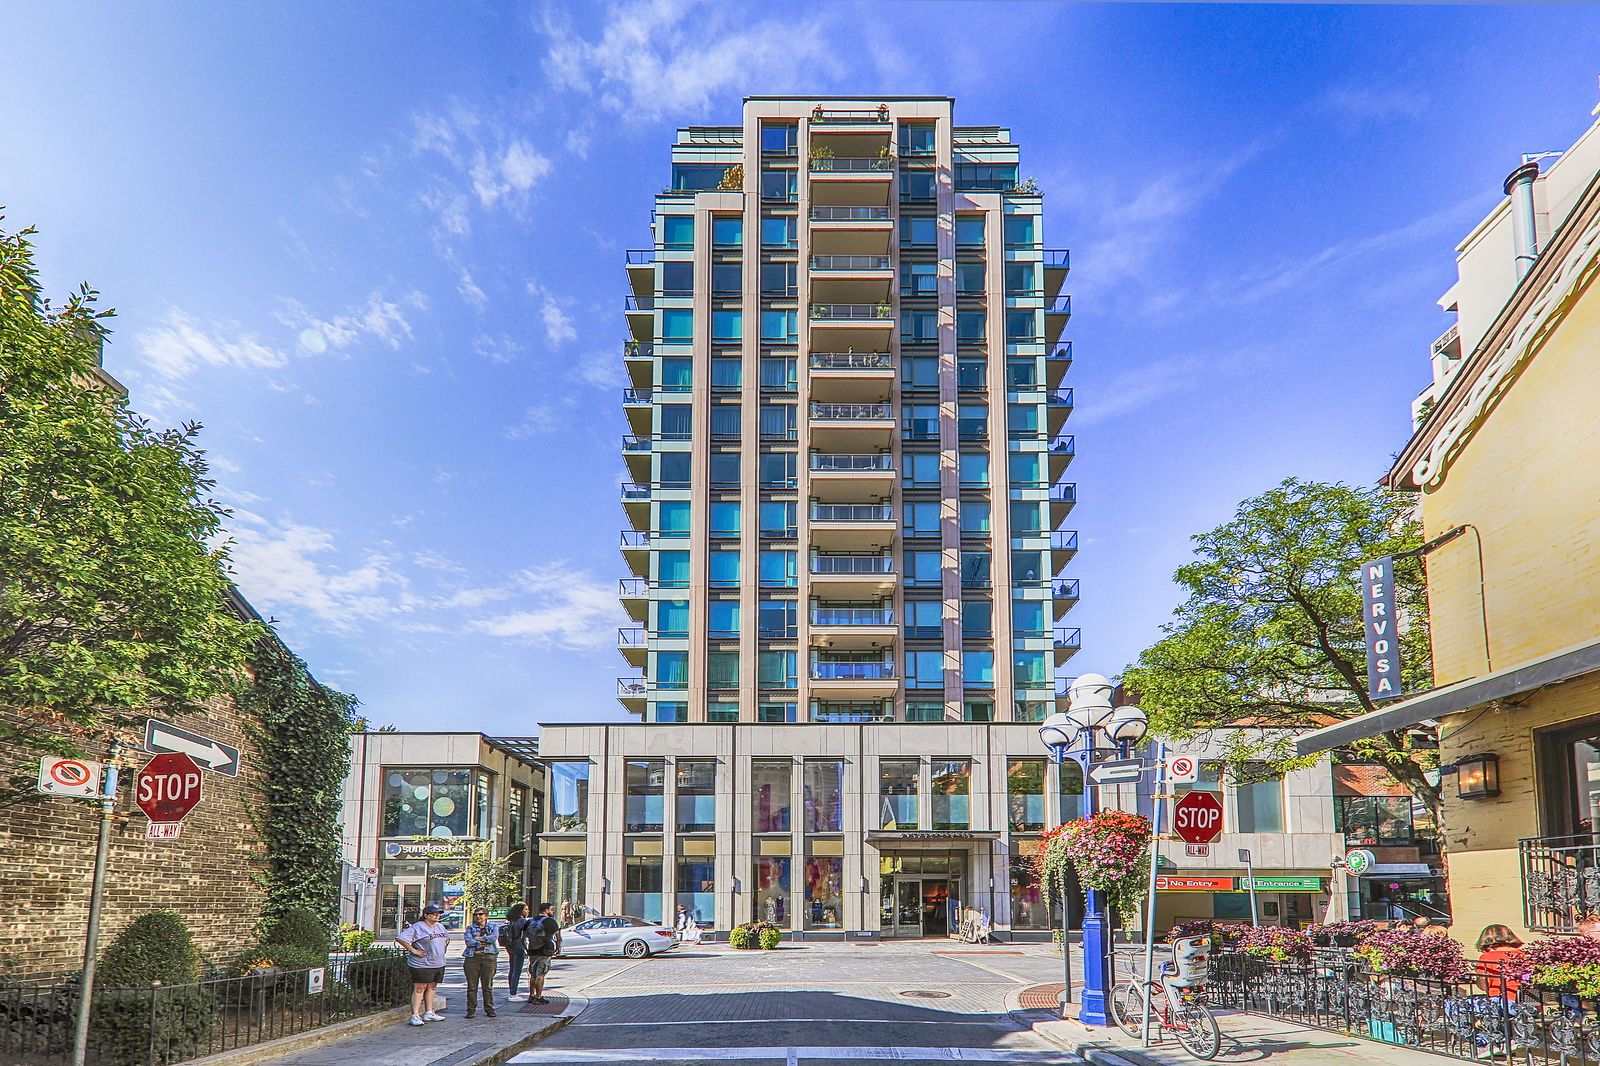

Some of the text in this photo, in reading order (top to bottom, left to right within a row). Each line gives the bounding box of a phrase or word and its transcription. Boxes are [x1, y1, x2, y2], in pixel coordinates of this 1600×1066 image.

[1369, 564, 1391, 693] NERVOSA
[139, 773, 199, 801] STOP
[1178, 807, 1219, 829] STOP
[149, 824, 178, 838] ALL-WAY
[1186, 880, 1213, 889] Entry
[1257, 880, 1300, 888] Entrance
